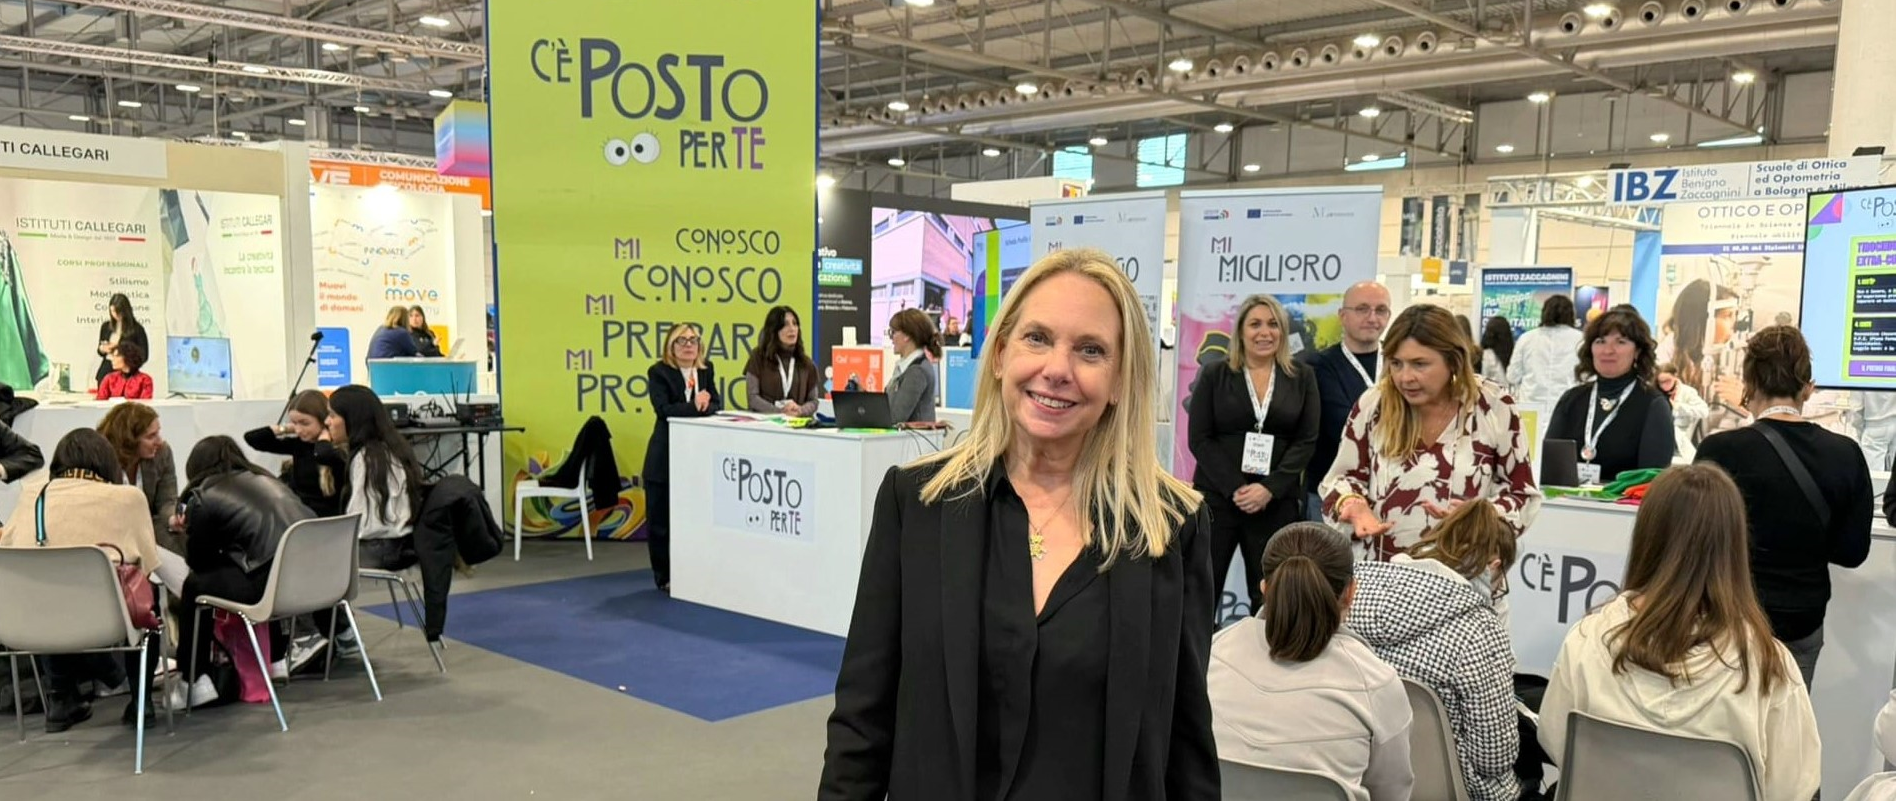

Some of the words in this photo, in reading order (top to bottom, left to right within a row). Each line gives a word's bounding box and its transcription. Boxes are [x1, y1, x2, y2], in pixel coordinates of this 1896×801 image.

[530, 38, 572, 83] C'È
[580, 38, 769, 122] POSTO
[20, 142, 109, 162] CALLEGARI
[679, 129, 728, 169] PER
[731, 126, 765, 170] TE
[1757, 163, 1794, 173] Scuole
[1797, 161, 1808, 170] di
[1811, 160, 1848, 170] Ottica
[379, 170, 471, 187] COMUNICAZIONE
[1614, 169, 1679, 202] IBZ
[1682, 167, 1717, 178] Istituto
[1681, 179, 1727, 190] Benigno
[1755, 175, 1770, 184] ed
[1773, 173, 1841, 185] Optometria
[1680, 187, 1742, 200] Zaccagnini
[1765, 186, 1813, 197] Bologna
[1698, 205, 1760, 219] OTTICO
[1765, 205, 1775, 217] E
[1779, 203, 1804, 216] OP
[16, 217, 71, 230] ISTITUTI
[74, 221, 146, 234] CALLEGARI
[614, 237, 640, 260] MI
[676, 228, 780, 255] CONOSCO
[1211, 236, 1232, 254] MI
[57, 259, 83, 267] CORSI
[84, 259, 148, 269] PROFESSIONALI
[1218, 253, 1342, 283] MIGLIORO
[109, 277, 149, 287] Stilismo
[319, 281, 347, 289] Muovi
[384, 272, 410, 287] ITS
[624, 264, 782, 304] CONOSCO
[1484, 273, 1519, 281] ISTITUTO
[1521, 273, 1569, 281] ZACCAGNINI
[326, 293, 358, 301] mondo
[385, 287, 439, 302] move
[320, 304, 329, 312] di
[585, 294, 614, 316] MI
[566, 349, 593, 371] MI
[738, 458, 802, 509] POSTO
[770, 510, 787, 534] PER
[788, 510, 801, 536] TE
[1520, 553, 1555, 592] C'È
